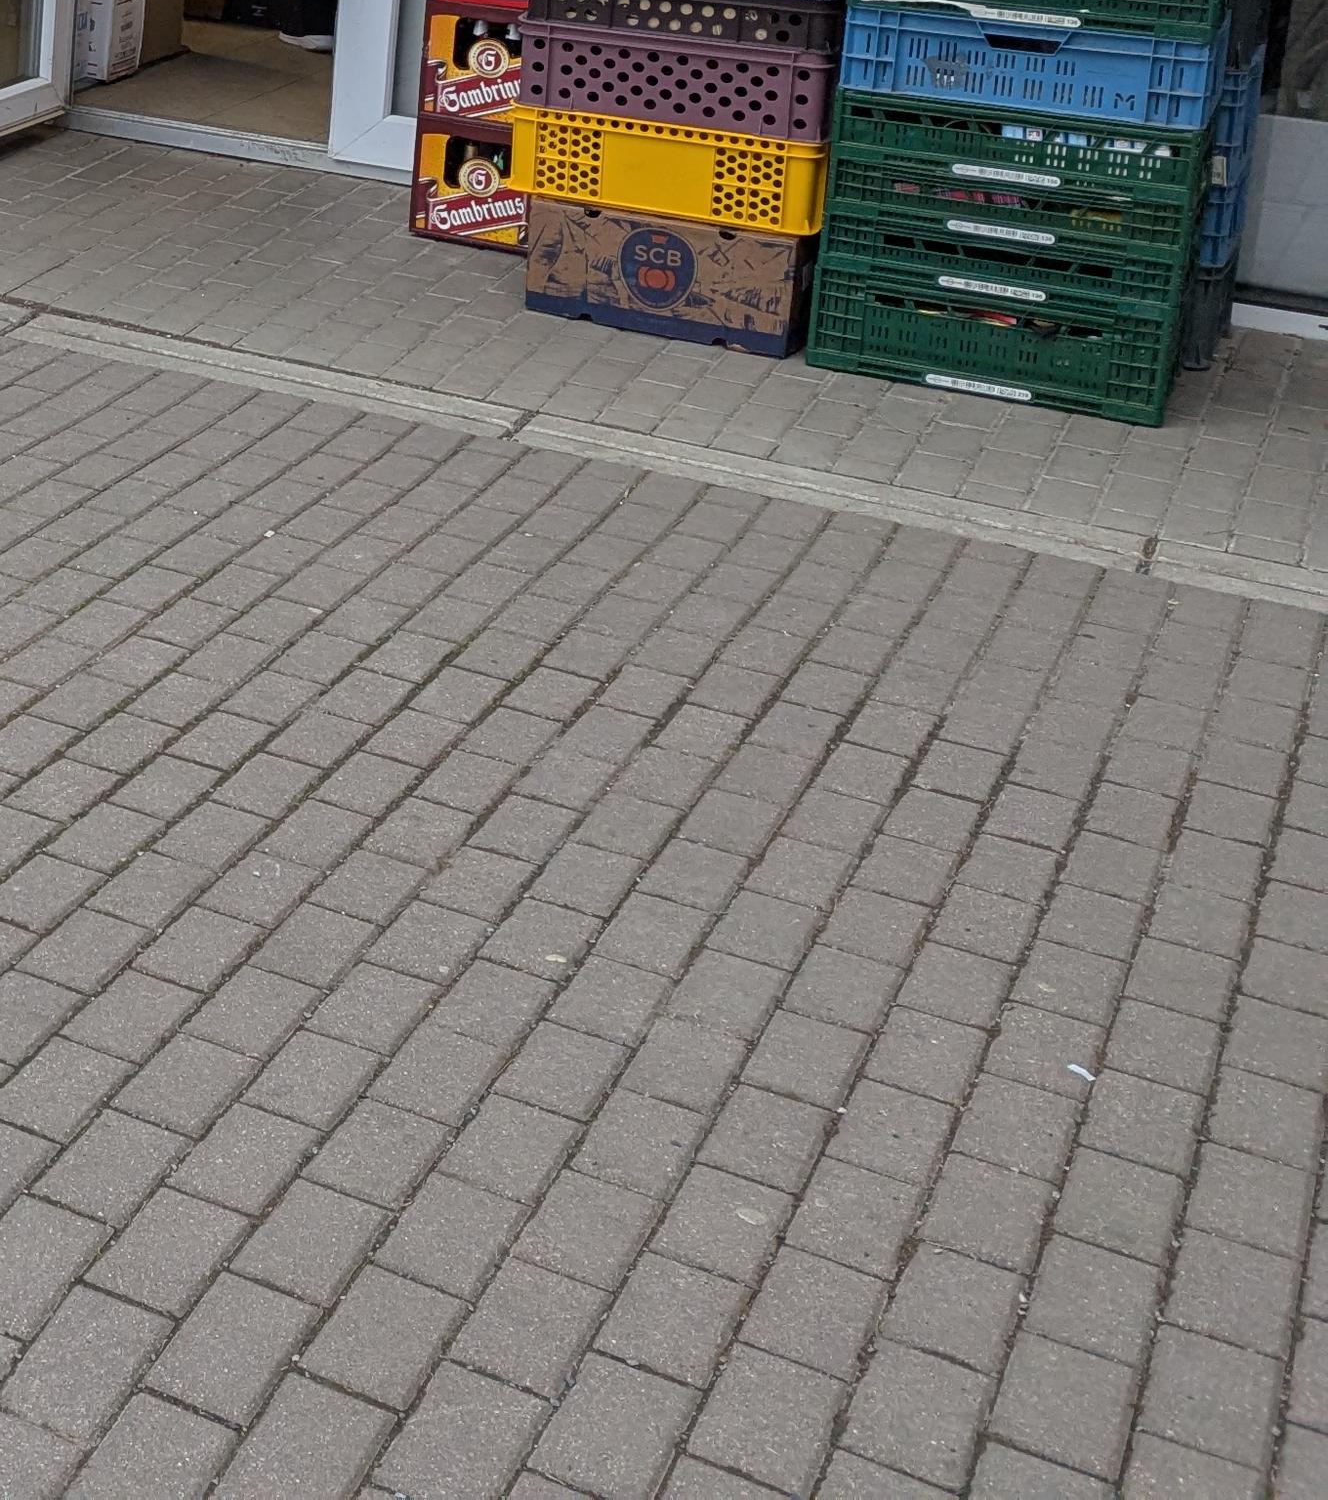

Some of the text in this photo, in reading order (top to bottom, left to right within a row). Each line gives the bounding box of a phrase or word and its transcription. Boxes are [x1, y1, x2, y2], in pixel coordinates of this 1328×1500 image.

[438, 77, 521, 113] Gambrin
[430, 196, 526, 230] Gambrinus
[634, 244, 682, 267] SCB
